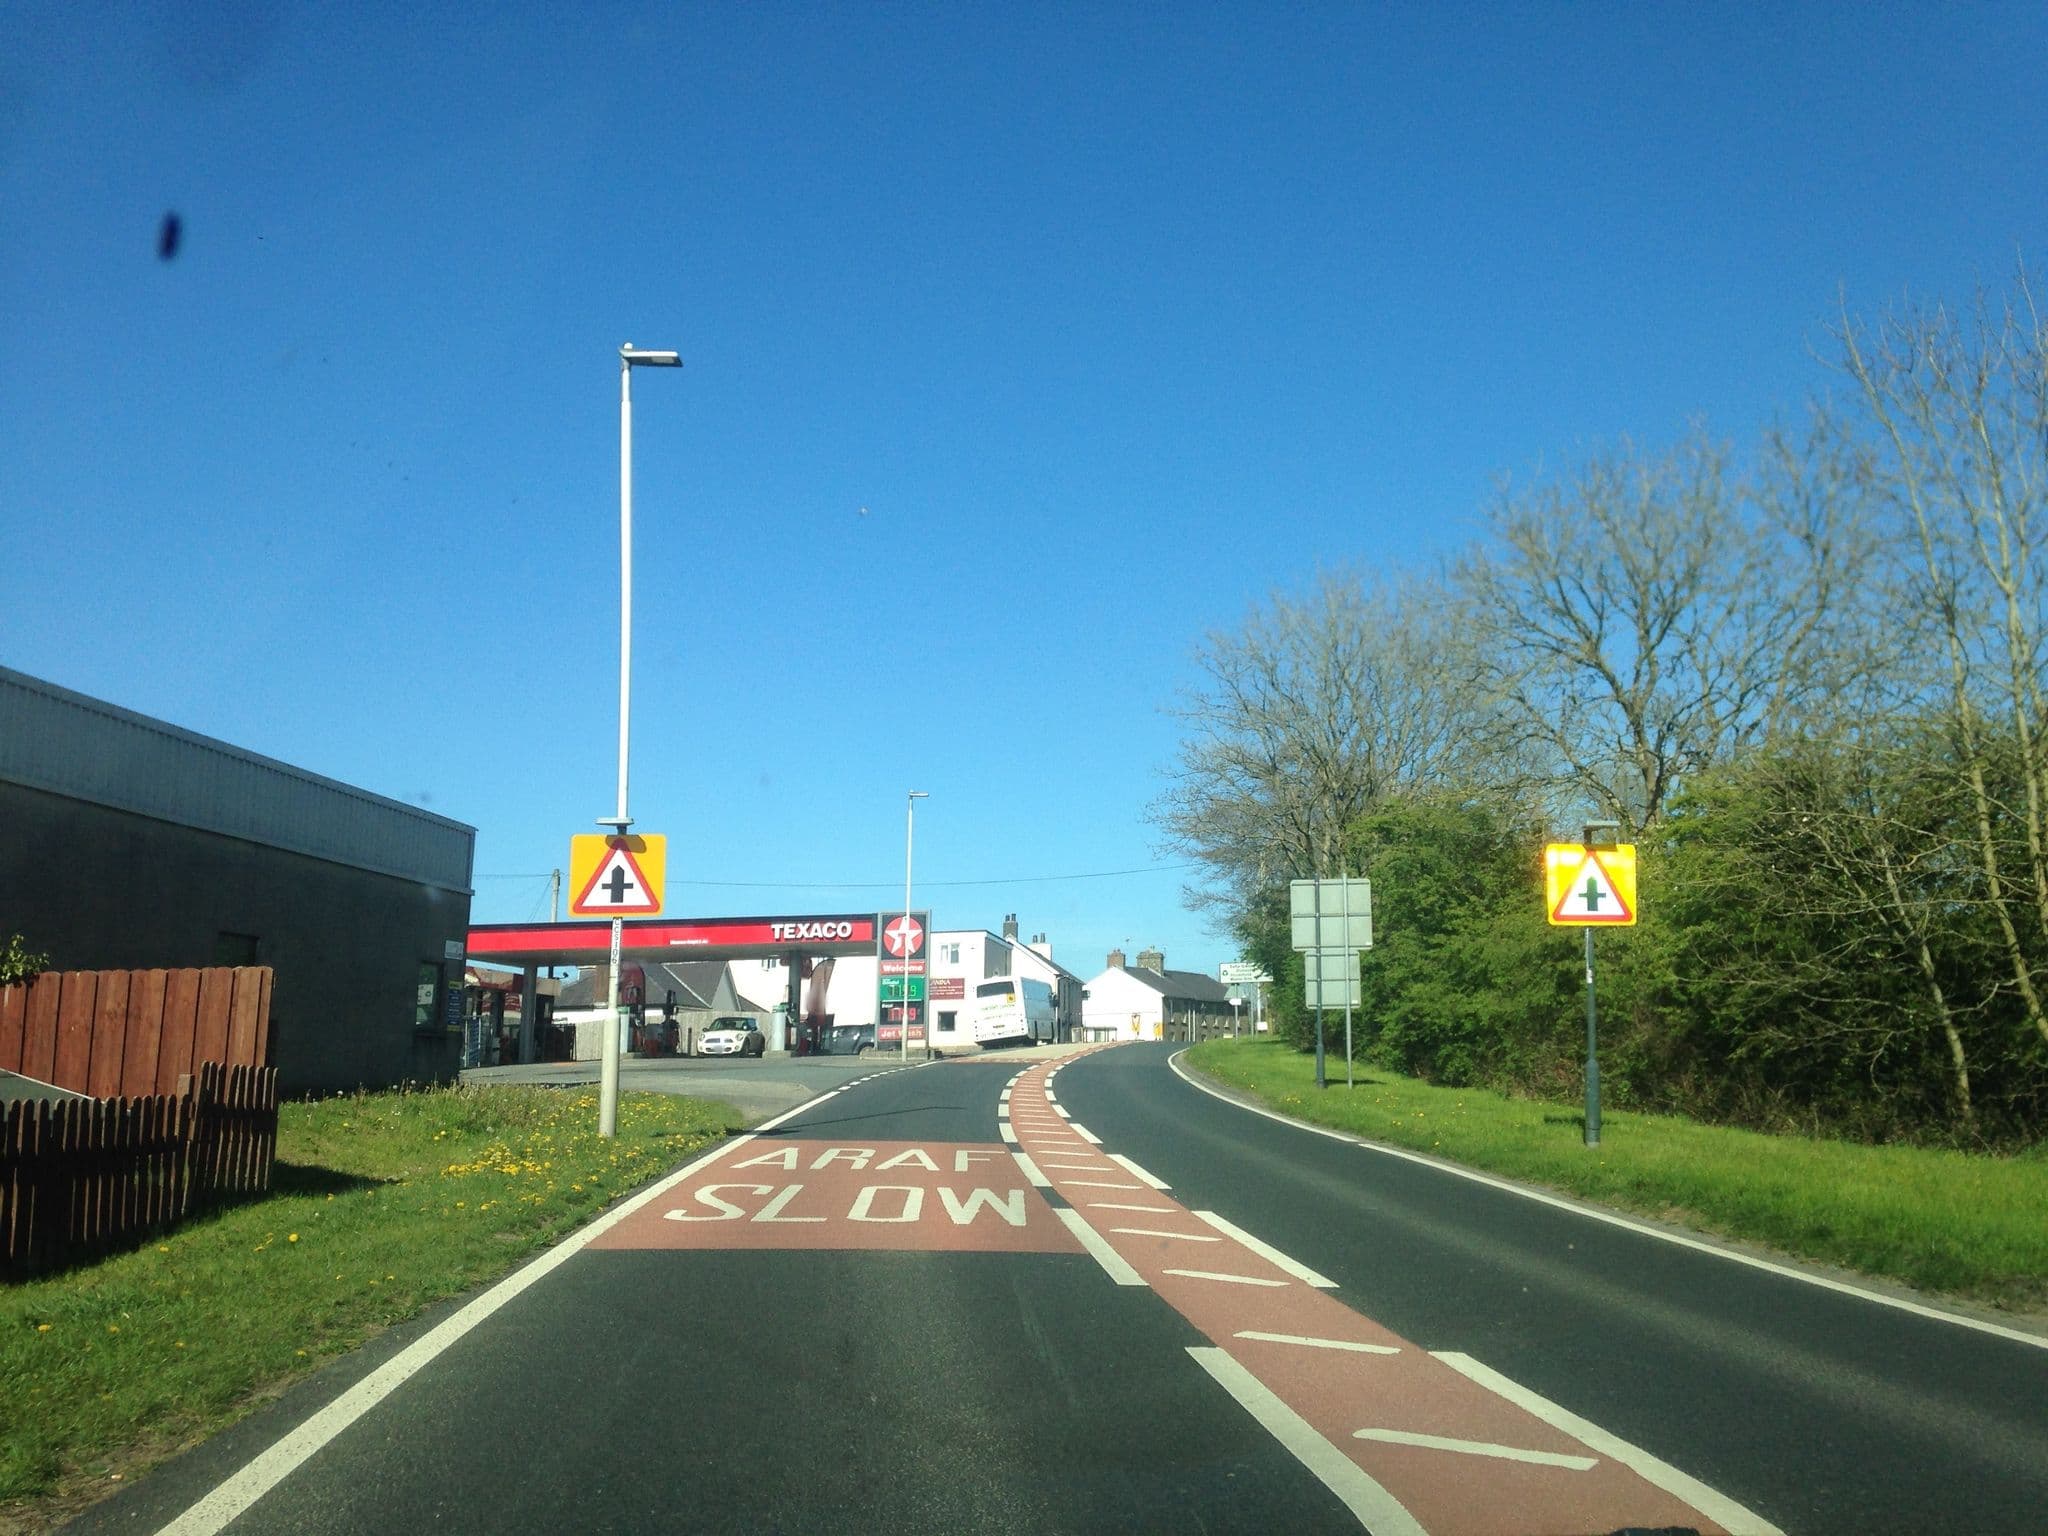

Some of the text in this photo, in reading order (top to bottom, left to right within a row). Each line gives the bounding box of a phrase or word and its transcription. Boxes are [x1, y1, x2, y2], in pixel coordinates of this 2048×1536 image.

[771, 922, 852, 939] TEXACO
[881, 1030, 896, 1038] Jet
[730, 1147, 1005, 1172] ARAF
[663, 1184, 1027, 1226] SLOW
